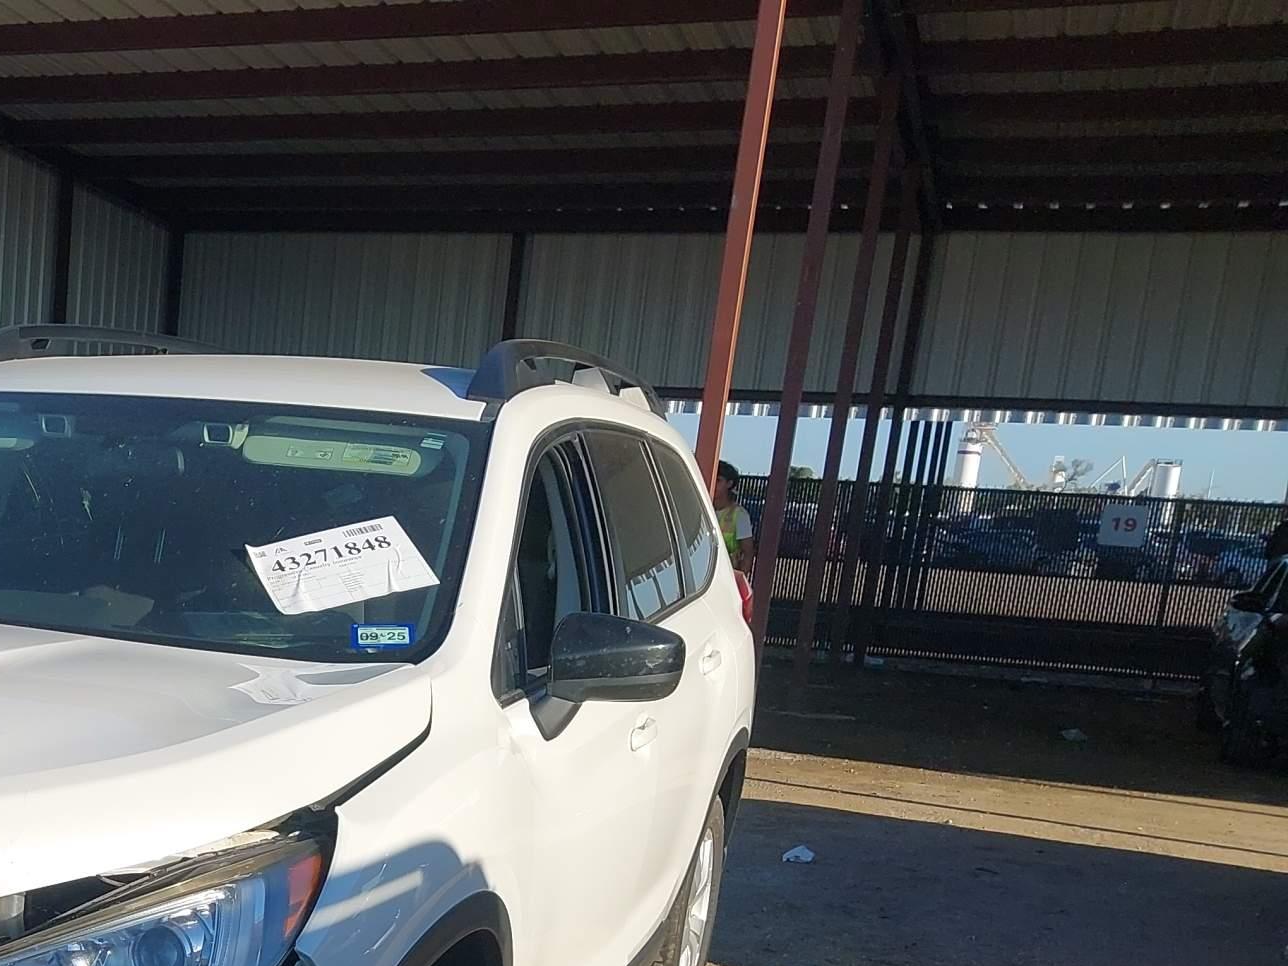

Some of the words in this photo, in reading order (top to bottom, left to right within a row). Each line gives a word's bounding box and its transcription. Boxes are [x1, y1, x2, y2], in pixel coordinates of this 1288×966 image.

[1111, 517, 1138, 532] 19
[271, 535, 392, 572] 43271848
[359, 631, 379, 641] 09
[386, 631, 406, 641] 25
